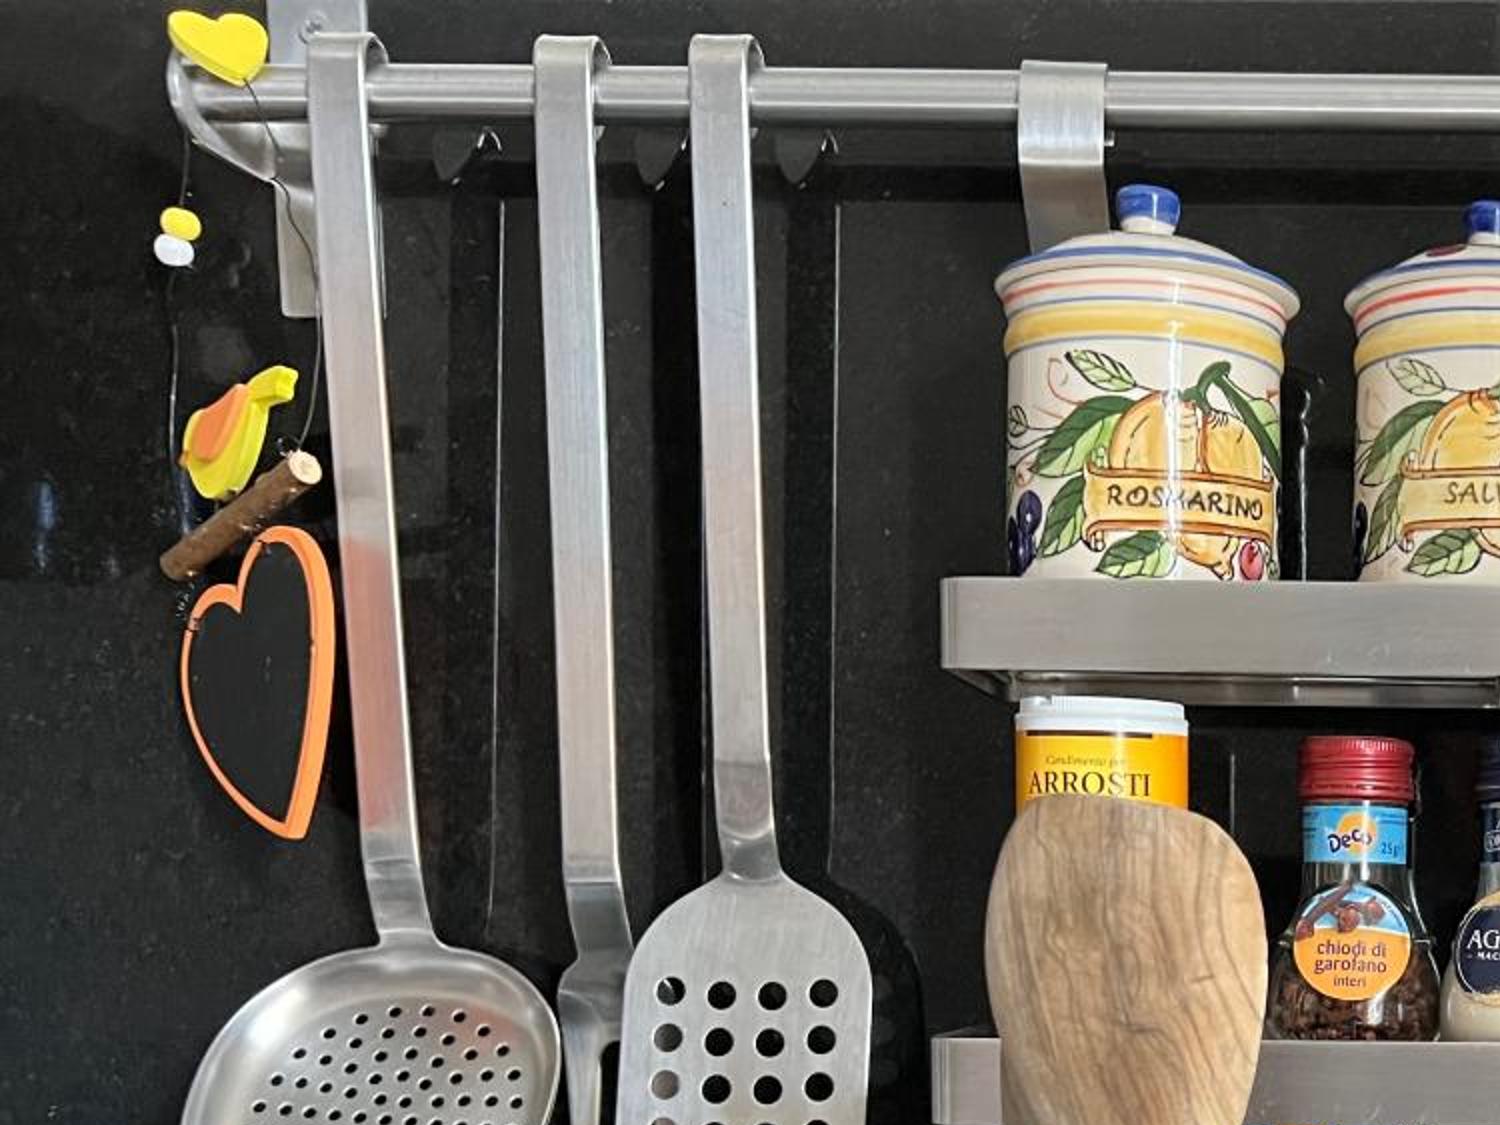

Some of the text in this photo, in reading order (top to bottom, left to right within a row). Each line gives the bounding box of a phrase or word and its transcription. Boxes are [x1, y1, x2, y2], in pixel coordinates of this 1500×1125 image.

[1107, 484, 1264, 520] ROSMARINO
[1029, 771, 1151, 797] ARROSTI
[1317, 940, 1387, 958] chiodi di
[1314, 957, 1387, 974] garofano
[1333, 975, 1367, 988] interi
